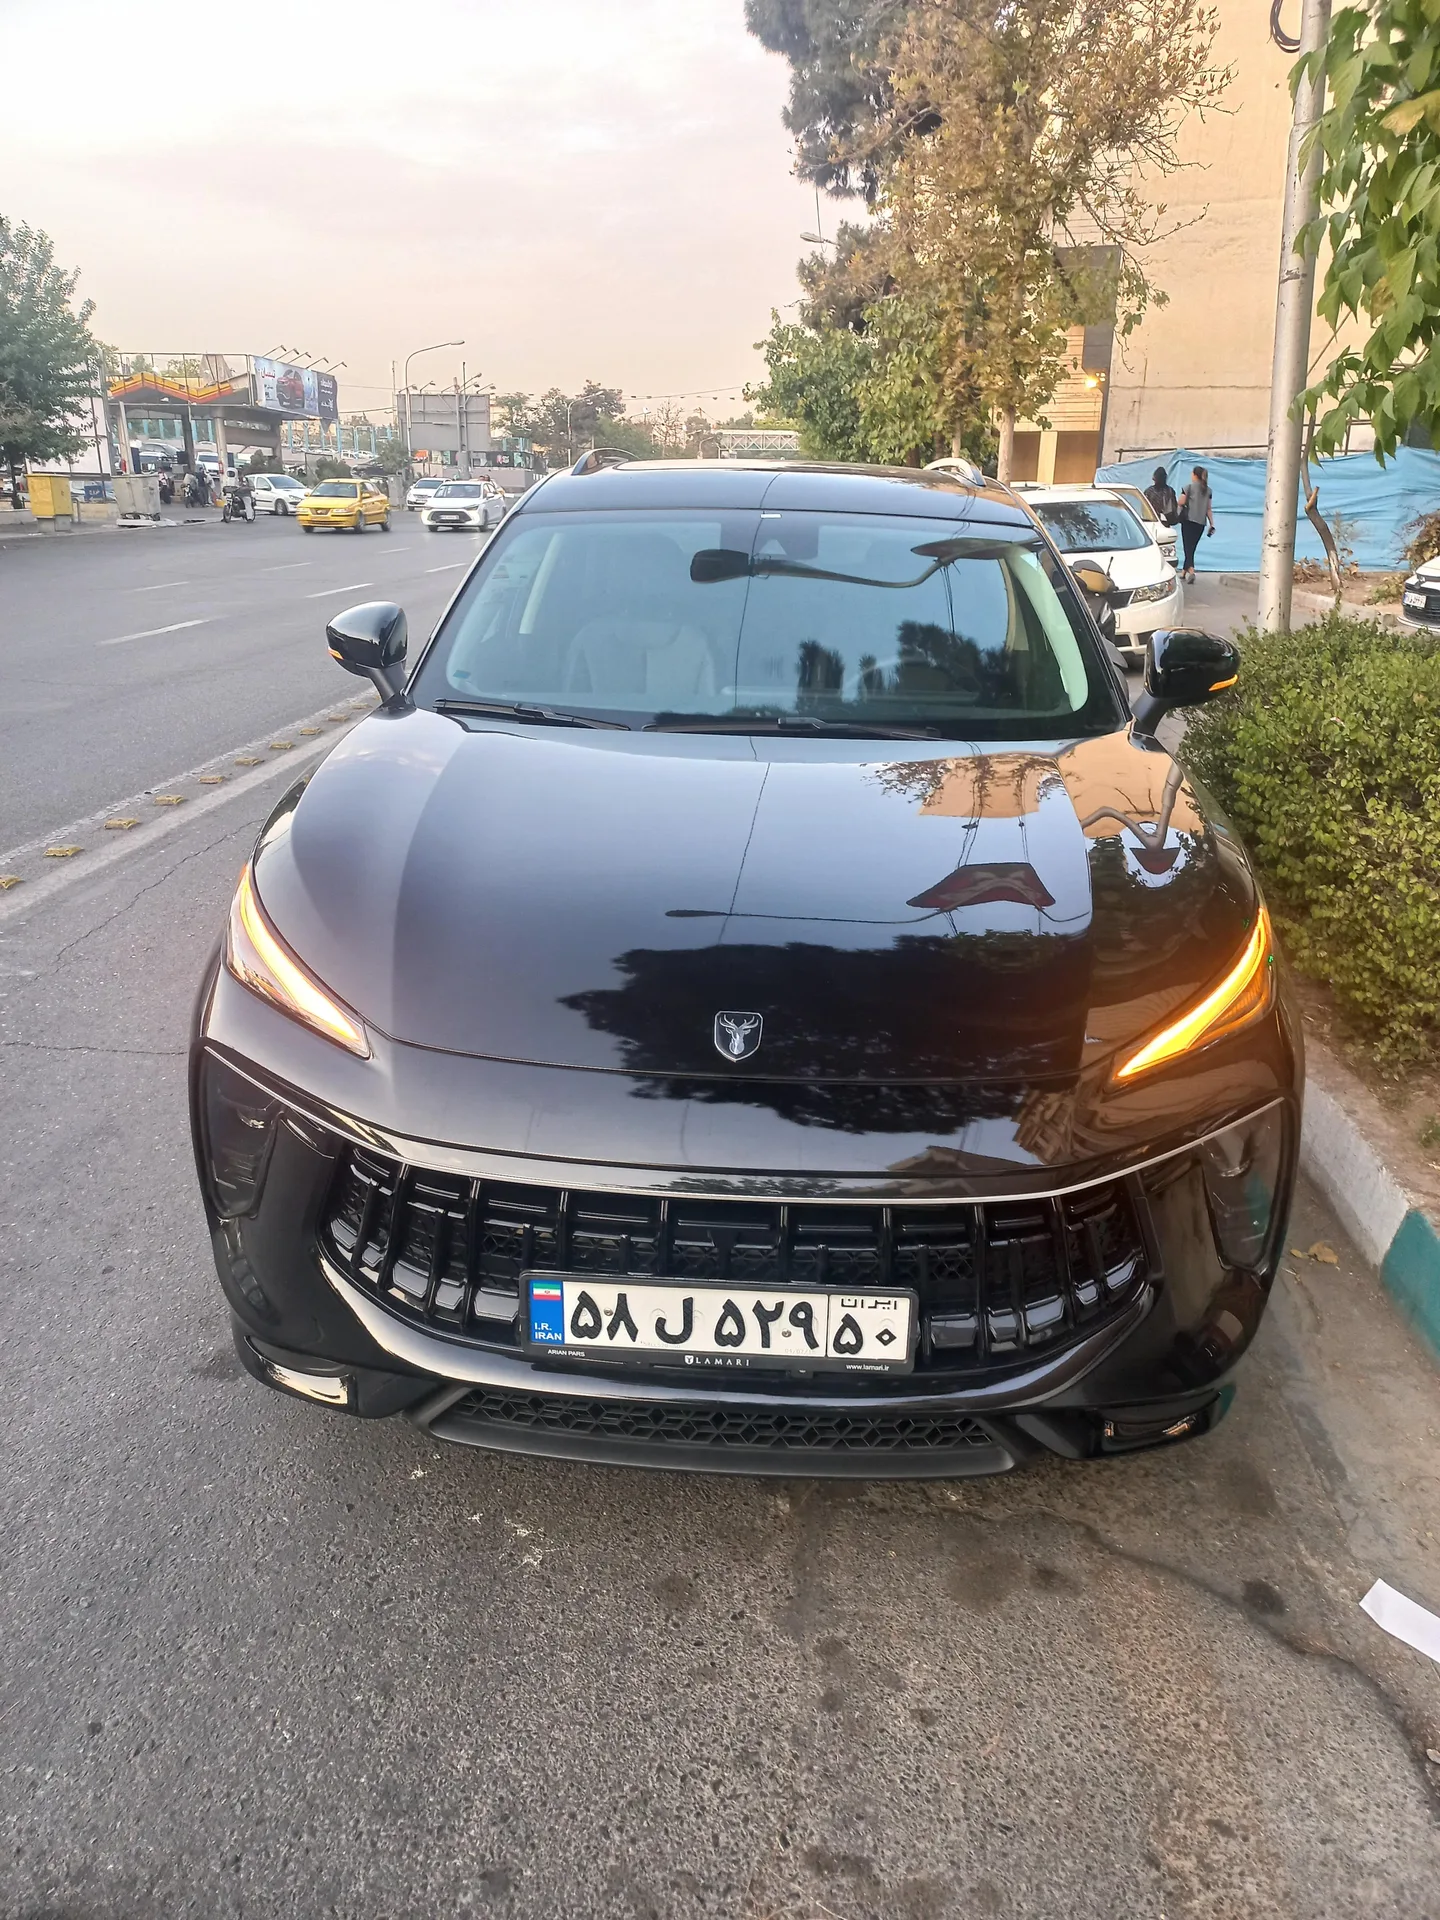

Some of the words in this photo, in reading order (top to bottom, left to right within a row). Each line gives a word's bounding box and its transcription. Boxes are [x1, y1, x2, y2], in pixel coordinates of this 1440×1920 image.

[841, 1298, 897, 1310] ایران
[570, 1290, 639, 1342] ۵۸
[655, 1296, 694, 1345] ل
[713, 1298, 821, 1349] ۵۲۹
[534, 1322, 552, 1331] I.R.
[534, 1331, 562, 1341] IRAN
[832, 1313, 897, 1355] ۵۰
[695, 1357, 751, 1366] LAMARI
[845, 1363, 890, 1371] www.lamari.ir
